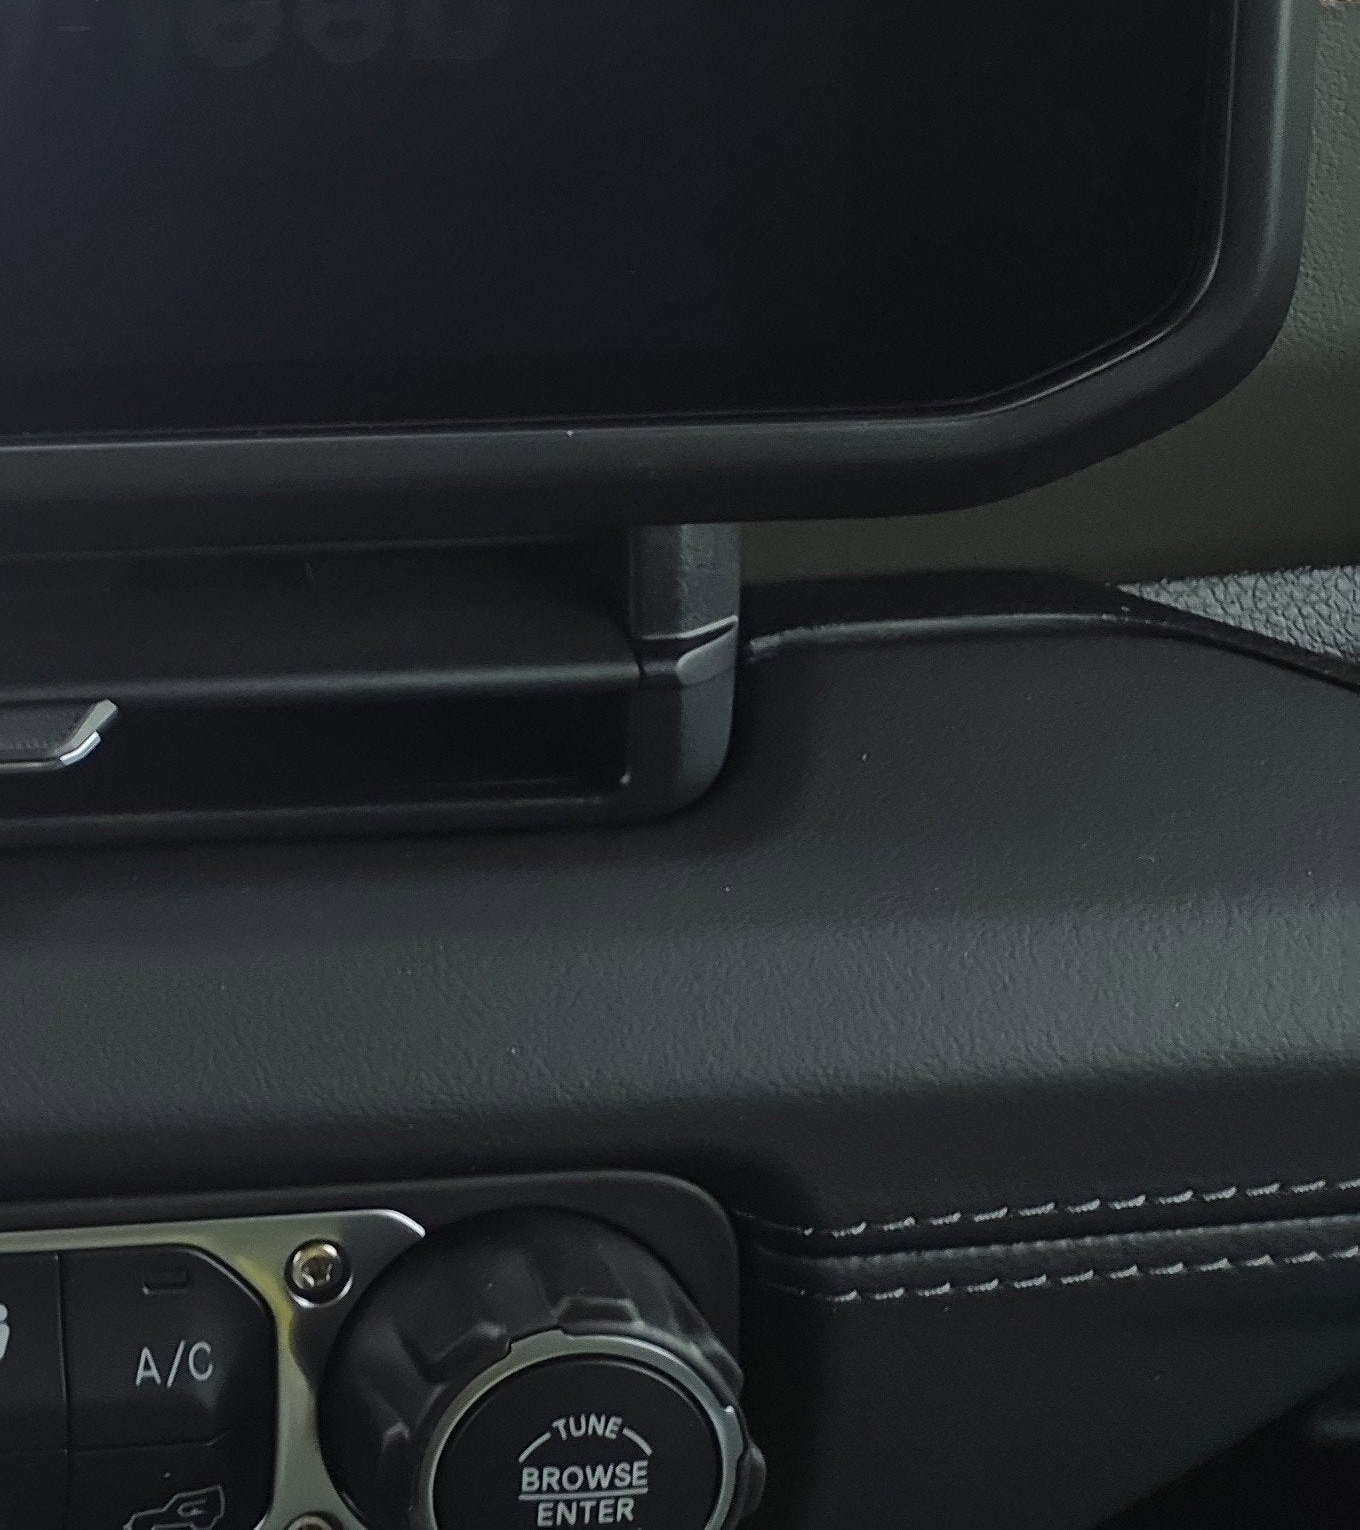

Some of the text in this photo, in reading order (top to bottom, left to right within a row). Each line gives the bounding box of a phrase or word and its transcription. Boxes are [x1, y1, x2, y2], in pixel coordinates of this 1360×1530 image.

[135, 1340, 215, 1388] A/C
[552, 1412, 623, 1442] TUNE
[520, 1460, 649, 1493] BROWSE
[537, 1497, 635, 1527] ENTER
